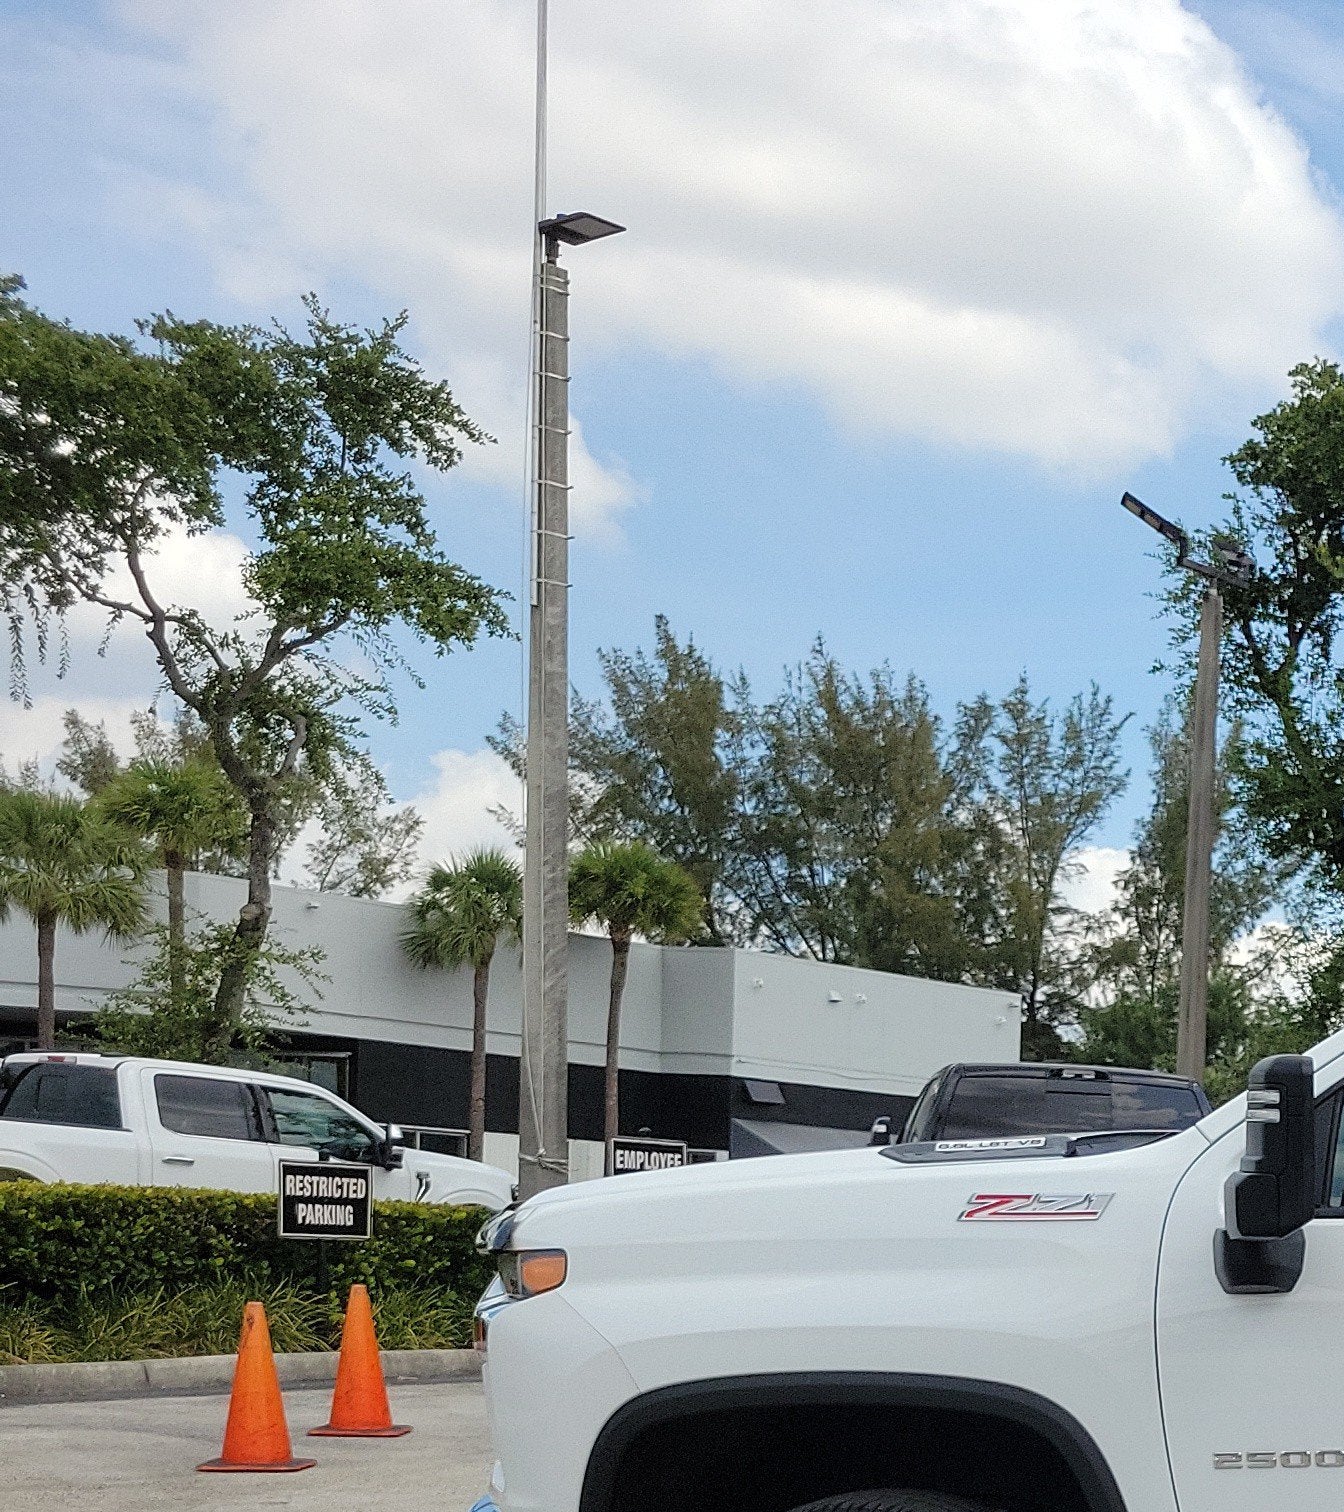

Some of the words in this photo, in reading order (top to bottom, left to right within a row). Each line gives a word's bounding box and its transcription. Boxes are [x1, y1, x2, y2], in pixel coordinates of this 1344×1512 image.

[615, 1149, 683, 1171] EMPLOYEE
[285, 1174, 367, 1200] RESTRICTED
[297, 1203, 354, 1227] PARKING
[957, 1193, 1116, 1221] Z71
